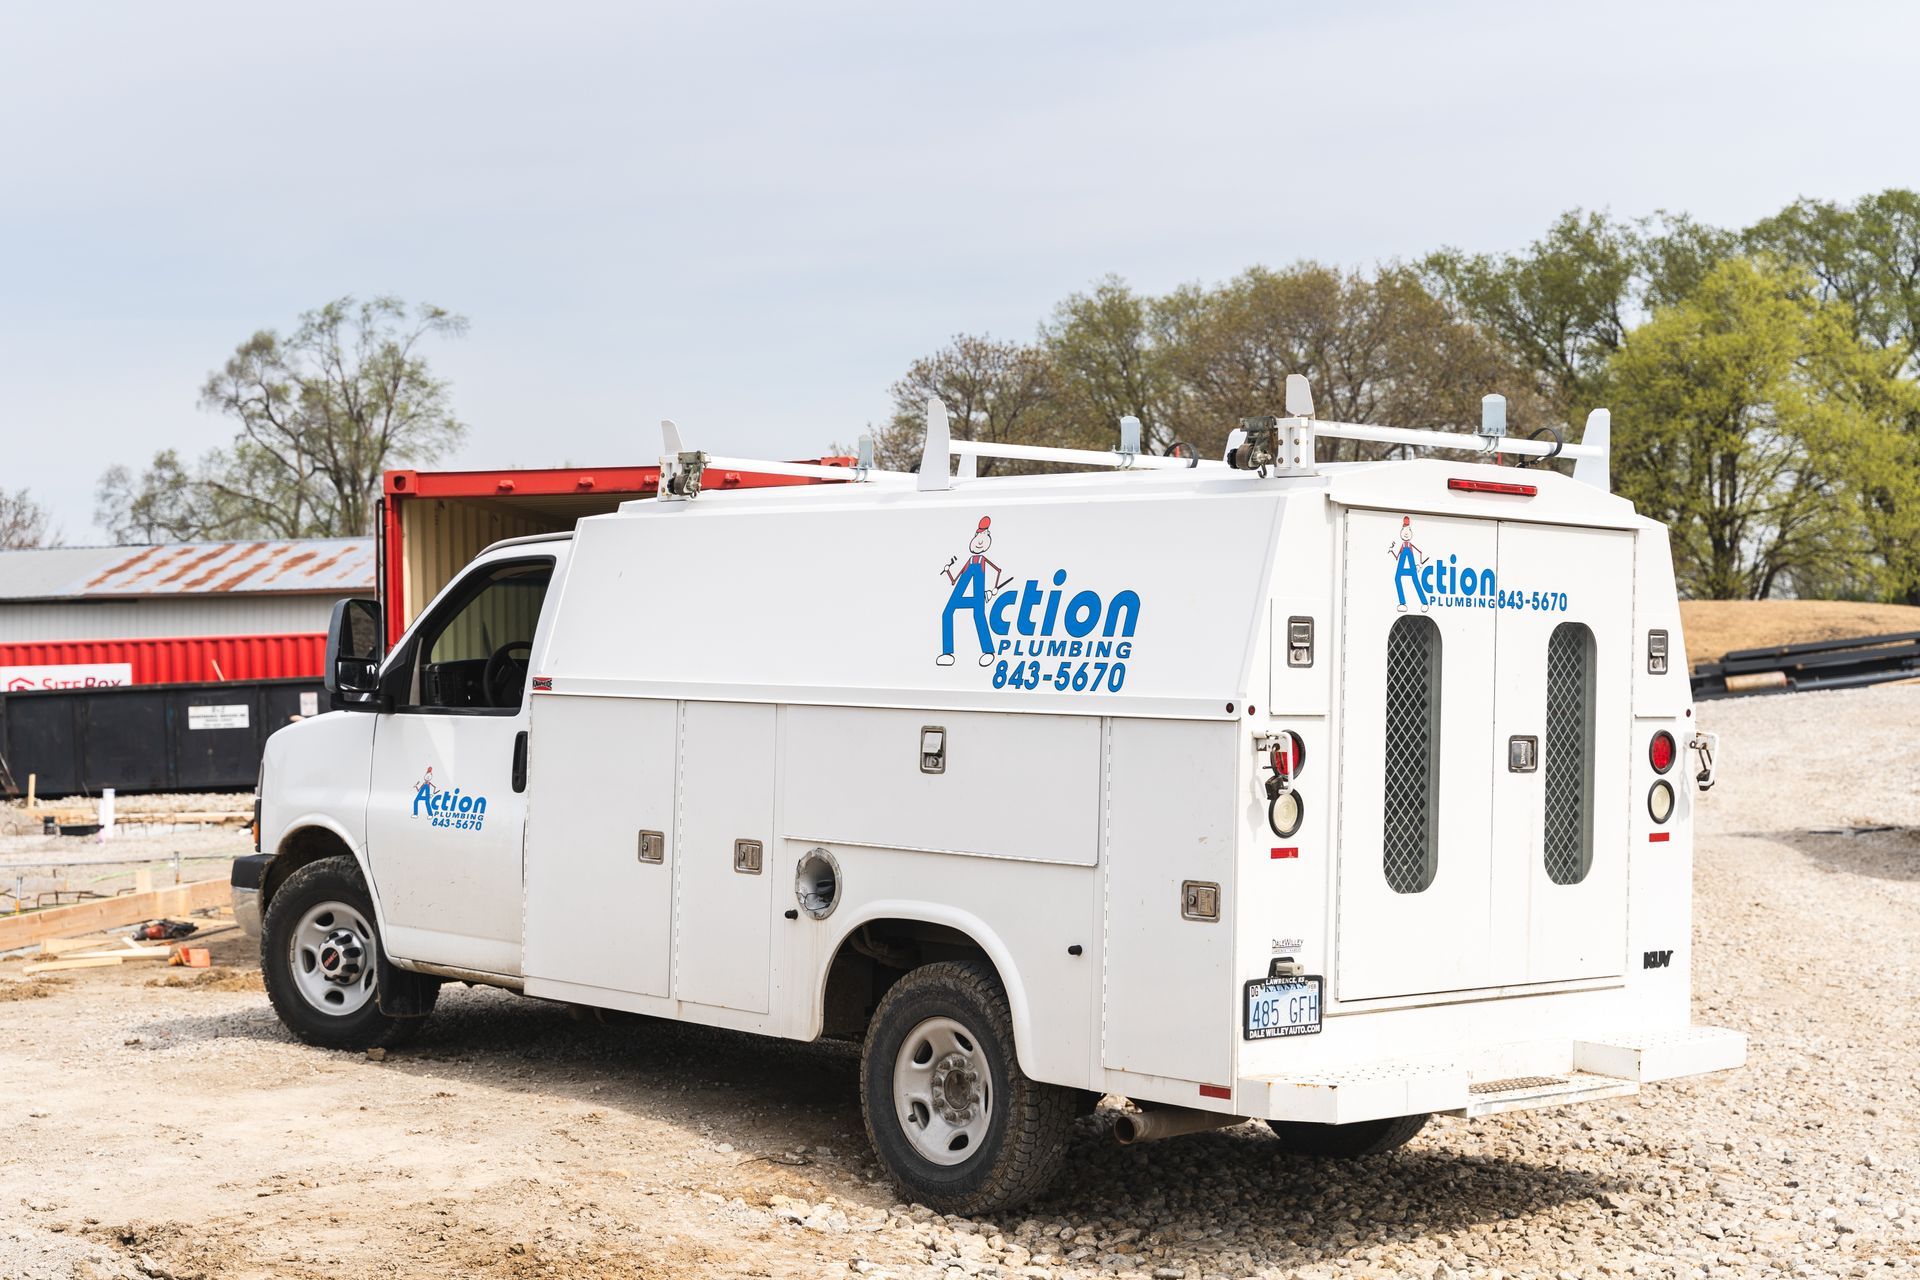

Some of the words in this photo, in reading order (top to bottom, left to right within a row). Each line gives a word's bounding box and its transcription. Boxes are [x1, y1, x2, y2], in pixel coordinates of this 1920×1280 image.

[1394, 547, 1496, 606] Action
[942, 560, 1141, 655] Action
[1429, 595, 1496, 609] PLUMBING
[1498, 589, 1568, 612] 843-5670
[997, 639, 1133, 659] PLUMBING
[992, 659, 1127, 693] 843-5670
[413, 783, 487, 817] Action
[431, 817, 483, 831] 843-5670
[433, 810, 485, 821] PLUMBING
[1643, 950, 1674, 970] KUV
[1251, 985, 1259, 997] DG
[1253, 999, 1279, 1028] 485
[1290, 995, 1317, 1023] GFH
[1249, 1028, 1265, 1039] DALE
